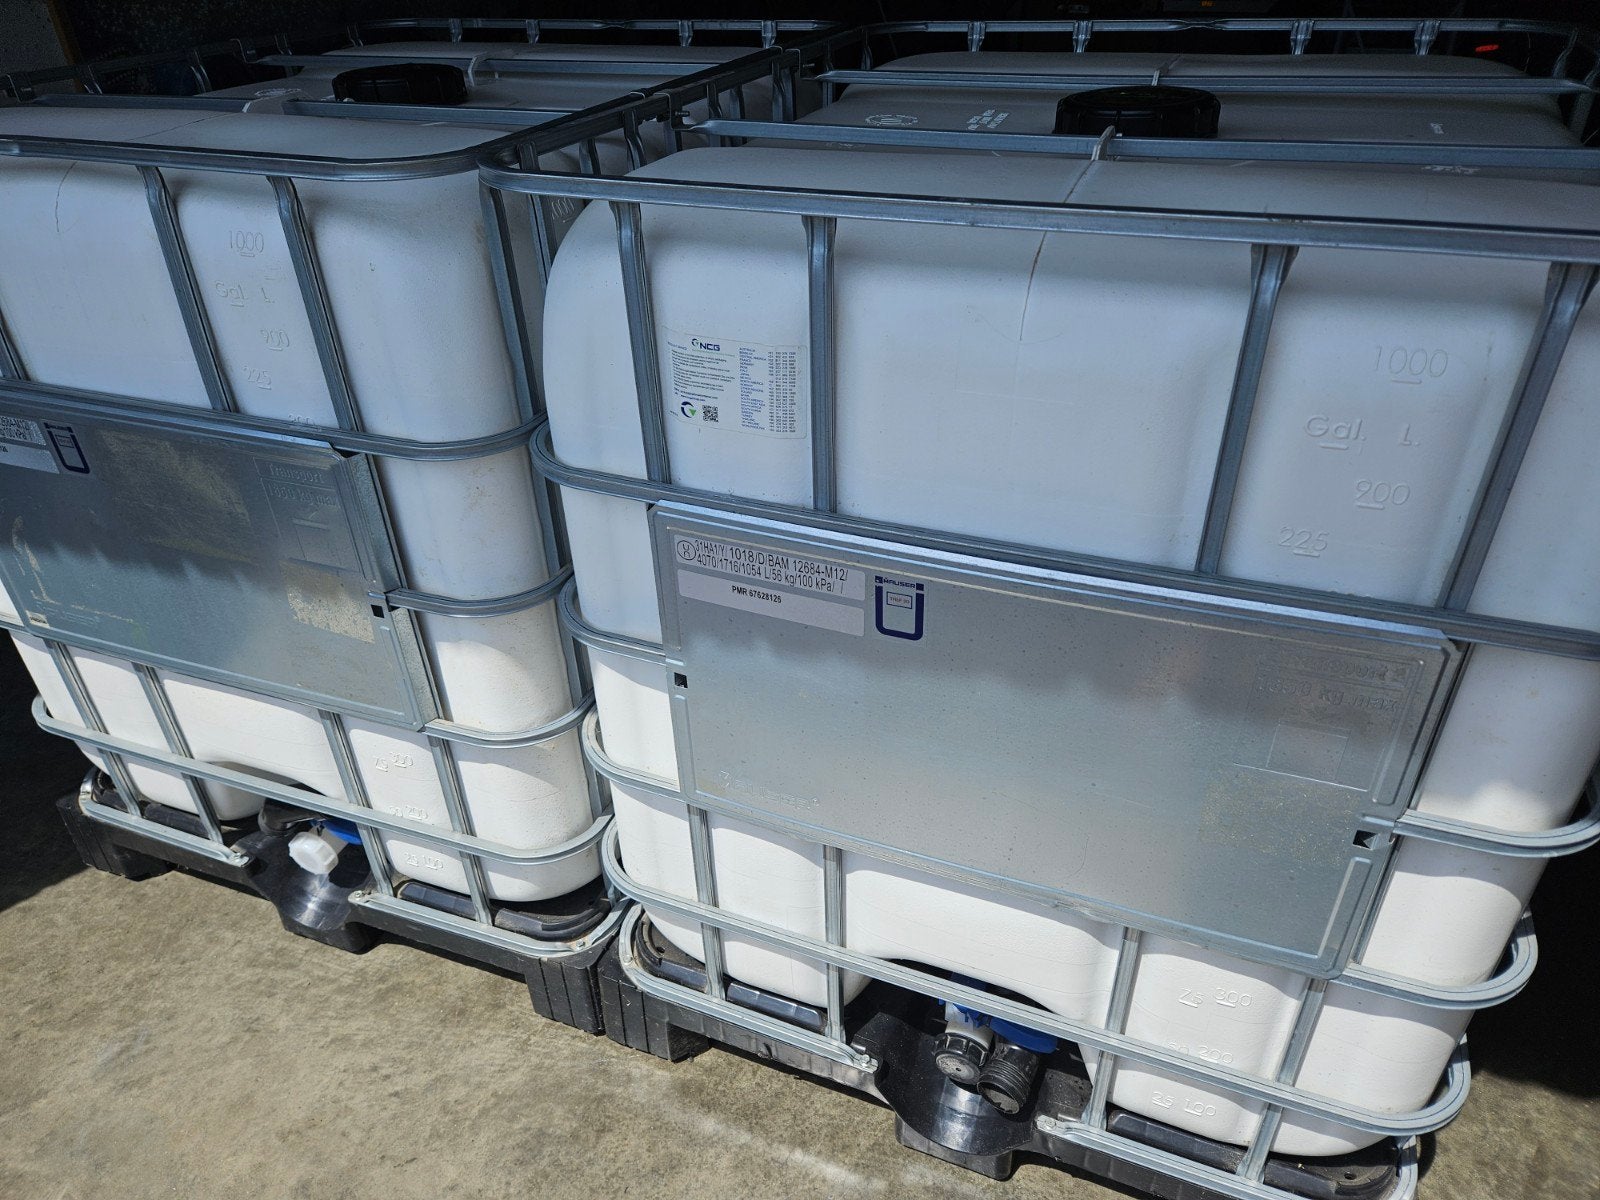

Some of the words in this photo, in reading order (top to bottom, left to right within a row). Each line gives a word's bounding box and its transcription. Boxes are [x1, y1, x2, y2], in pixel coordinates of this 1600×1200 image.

[227, 230, 265, 254] 1000
[699, 342, 721, 352] NCG
[1373, 345, 1449, 378] 1000
[1304, 414, 1367, 442] Gal.
[1278, 526, 1330, 551] 225
[785, 571, 813, 587] kg/100
[731, 585, 748, 596] PMR
[1213, 987, 1253, 1007] 300
[1199, 1045, 1233, 1064] 200
[1152, 1091, 1177, 1106] 25
[1185, 1098, 1217, 1116] 100
